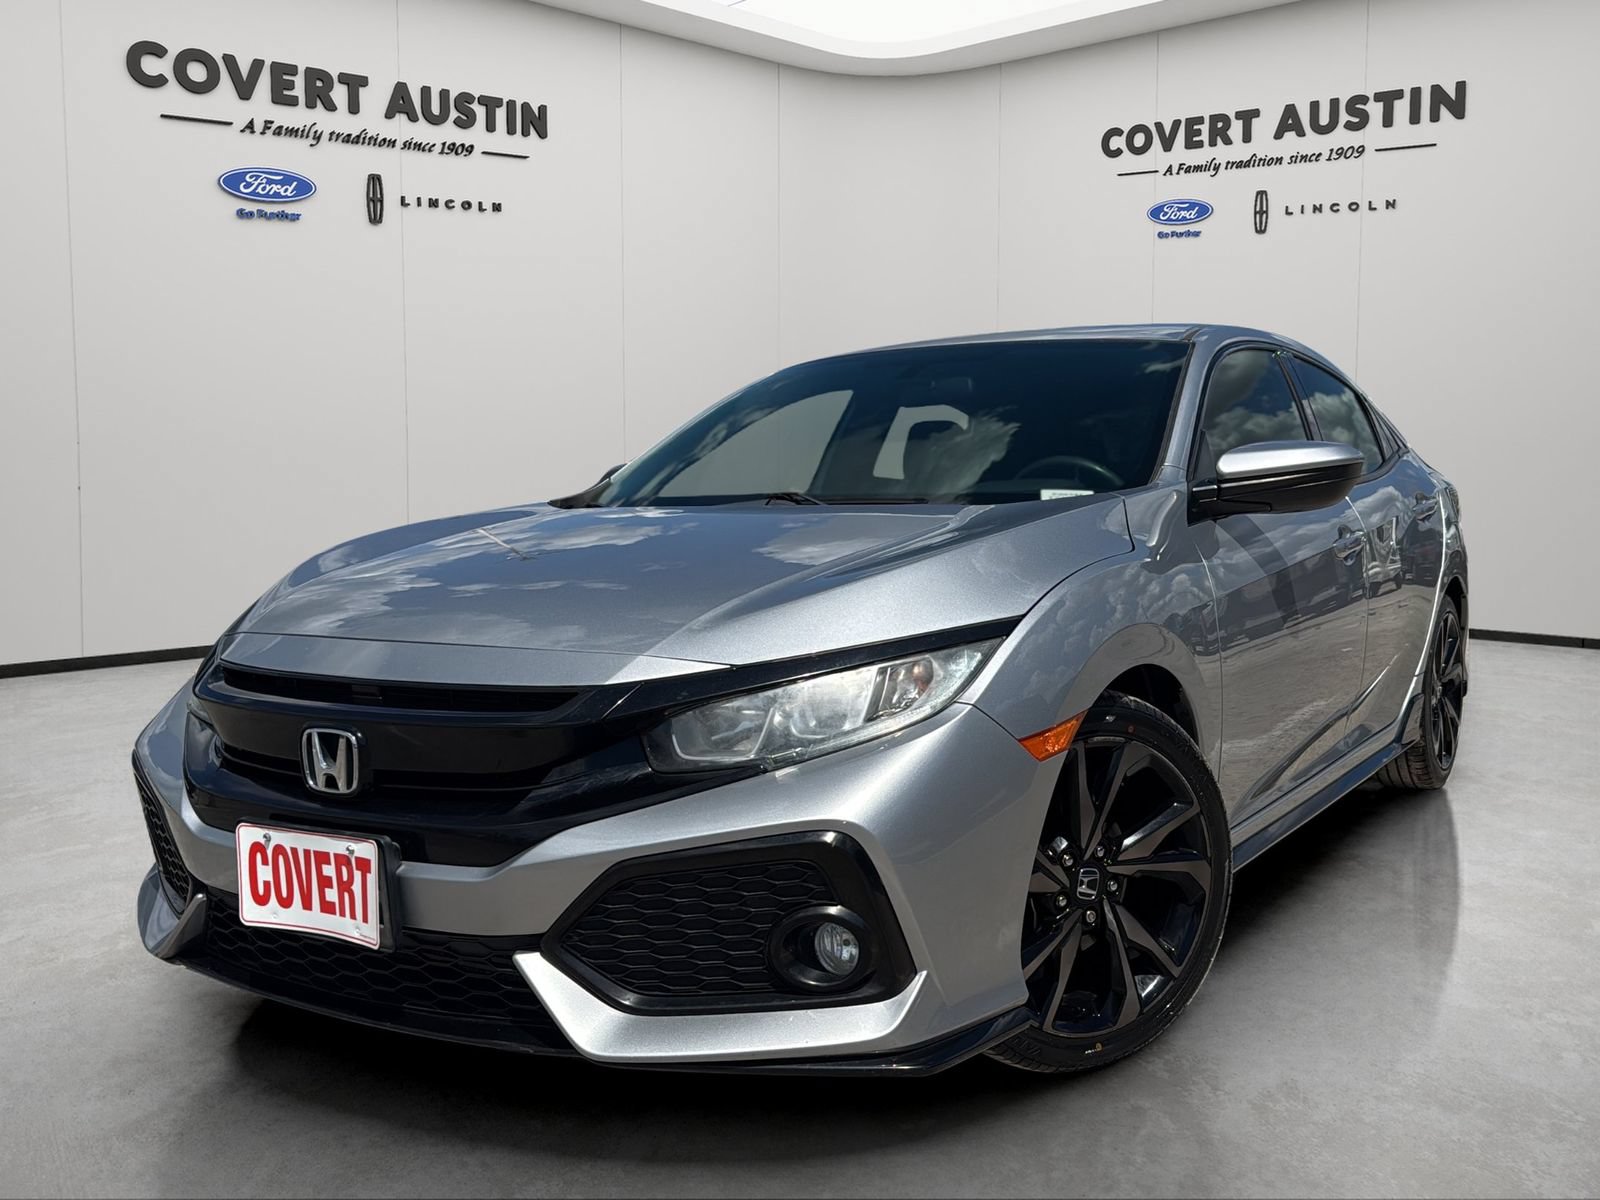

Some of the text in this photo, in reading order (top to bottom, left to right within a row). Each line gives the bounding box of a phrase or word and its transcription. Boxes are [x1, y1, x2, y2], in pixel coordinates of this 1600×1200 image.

[126, 40, 548, 140] COVERT AUSTIN
[1100, 80, 1467, 159] COVERT AUSTIN
[240, 117, 475, 158] A Family tradition since 1909
[1162, 144, 1366, 178] A Family tradition since 1909
[240, 171, 298, 197] Ford
[236, 207, 255, 219] Go
[400, 195, 502, 213] LINCOLN
[1159, 203, 1199, 220] Ford
[1284, 198, 1397, 217] LINCOLN
[1157, 231, 1170, 239] Go
[248, 841, 372, 924] COVERT
